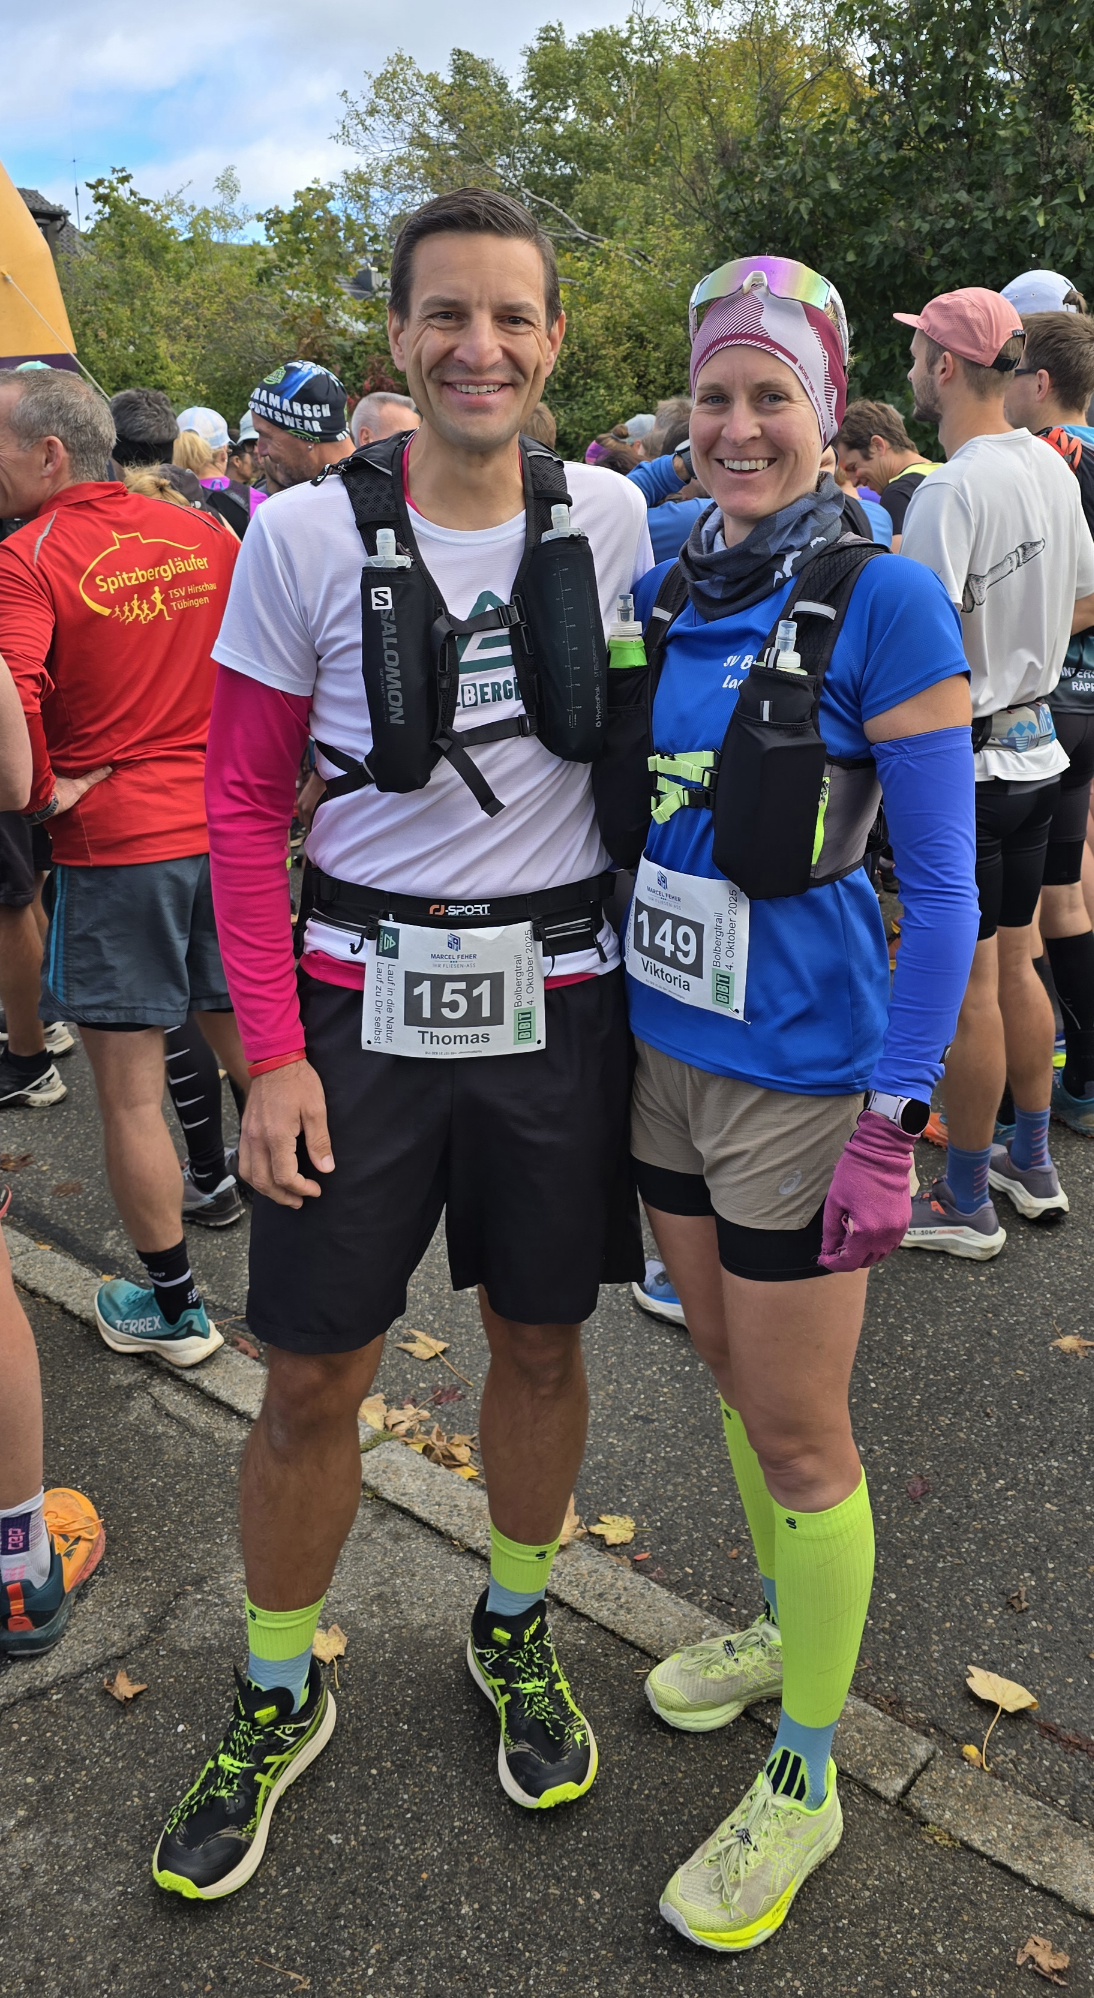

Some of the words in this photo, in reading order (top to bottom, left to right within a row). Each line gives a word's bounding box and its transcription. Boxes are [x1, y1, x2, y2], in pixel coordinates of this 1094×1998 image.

[95, 554, 209, 594] Spitzbergläufer
[168, 586, 186, 599] TSV
[187, 582, 217, 595] Hirschau
[170, 596, 210, 611] Tübingen
[380, 607, 405, 725] SALOMON
[723, 655, 741, 667] SV
[740, 654, 757, 670] B
[727, 889, 738, 916] 2025
[524, 929, 533, 954] 2025
[637, 909, 697, 965] 149
[712, 912, 724, 968] Bolbergtrail
[725, 919, 737, 958] Oktober
[376, 961, 385, 985] Lauf
[387, 963, 396, 988] Lauf
[525, 956, 534, 994] Oktober
[641, 957, 691, 992] Viktoria
[725, 961, 734, 971] 4.
[375, 986, 383, 997] zu
[387, 989, 394, 997] in
[514, 954, 524, 1008] Bolbergtrail
[374, 998, 383, 1013] Dir
[386, 998, 395, 1014] die
[413, 979, 491, 1020] 151
[526, 996, 534, 1006] 4.
[373, 1015, 383, 1044] selbst
[385, 1016, 396, 1044] Natur,
[417, 1030, 491, 1045] Thomas
[115, 1315, 162, 1334] TERREX
